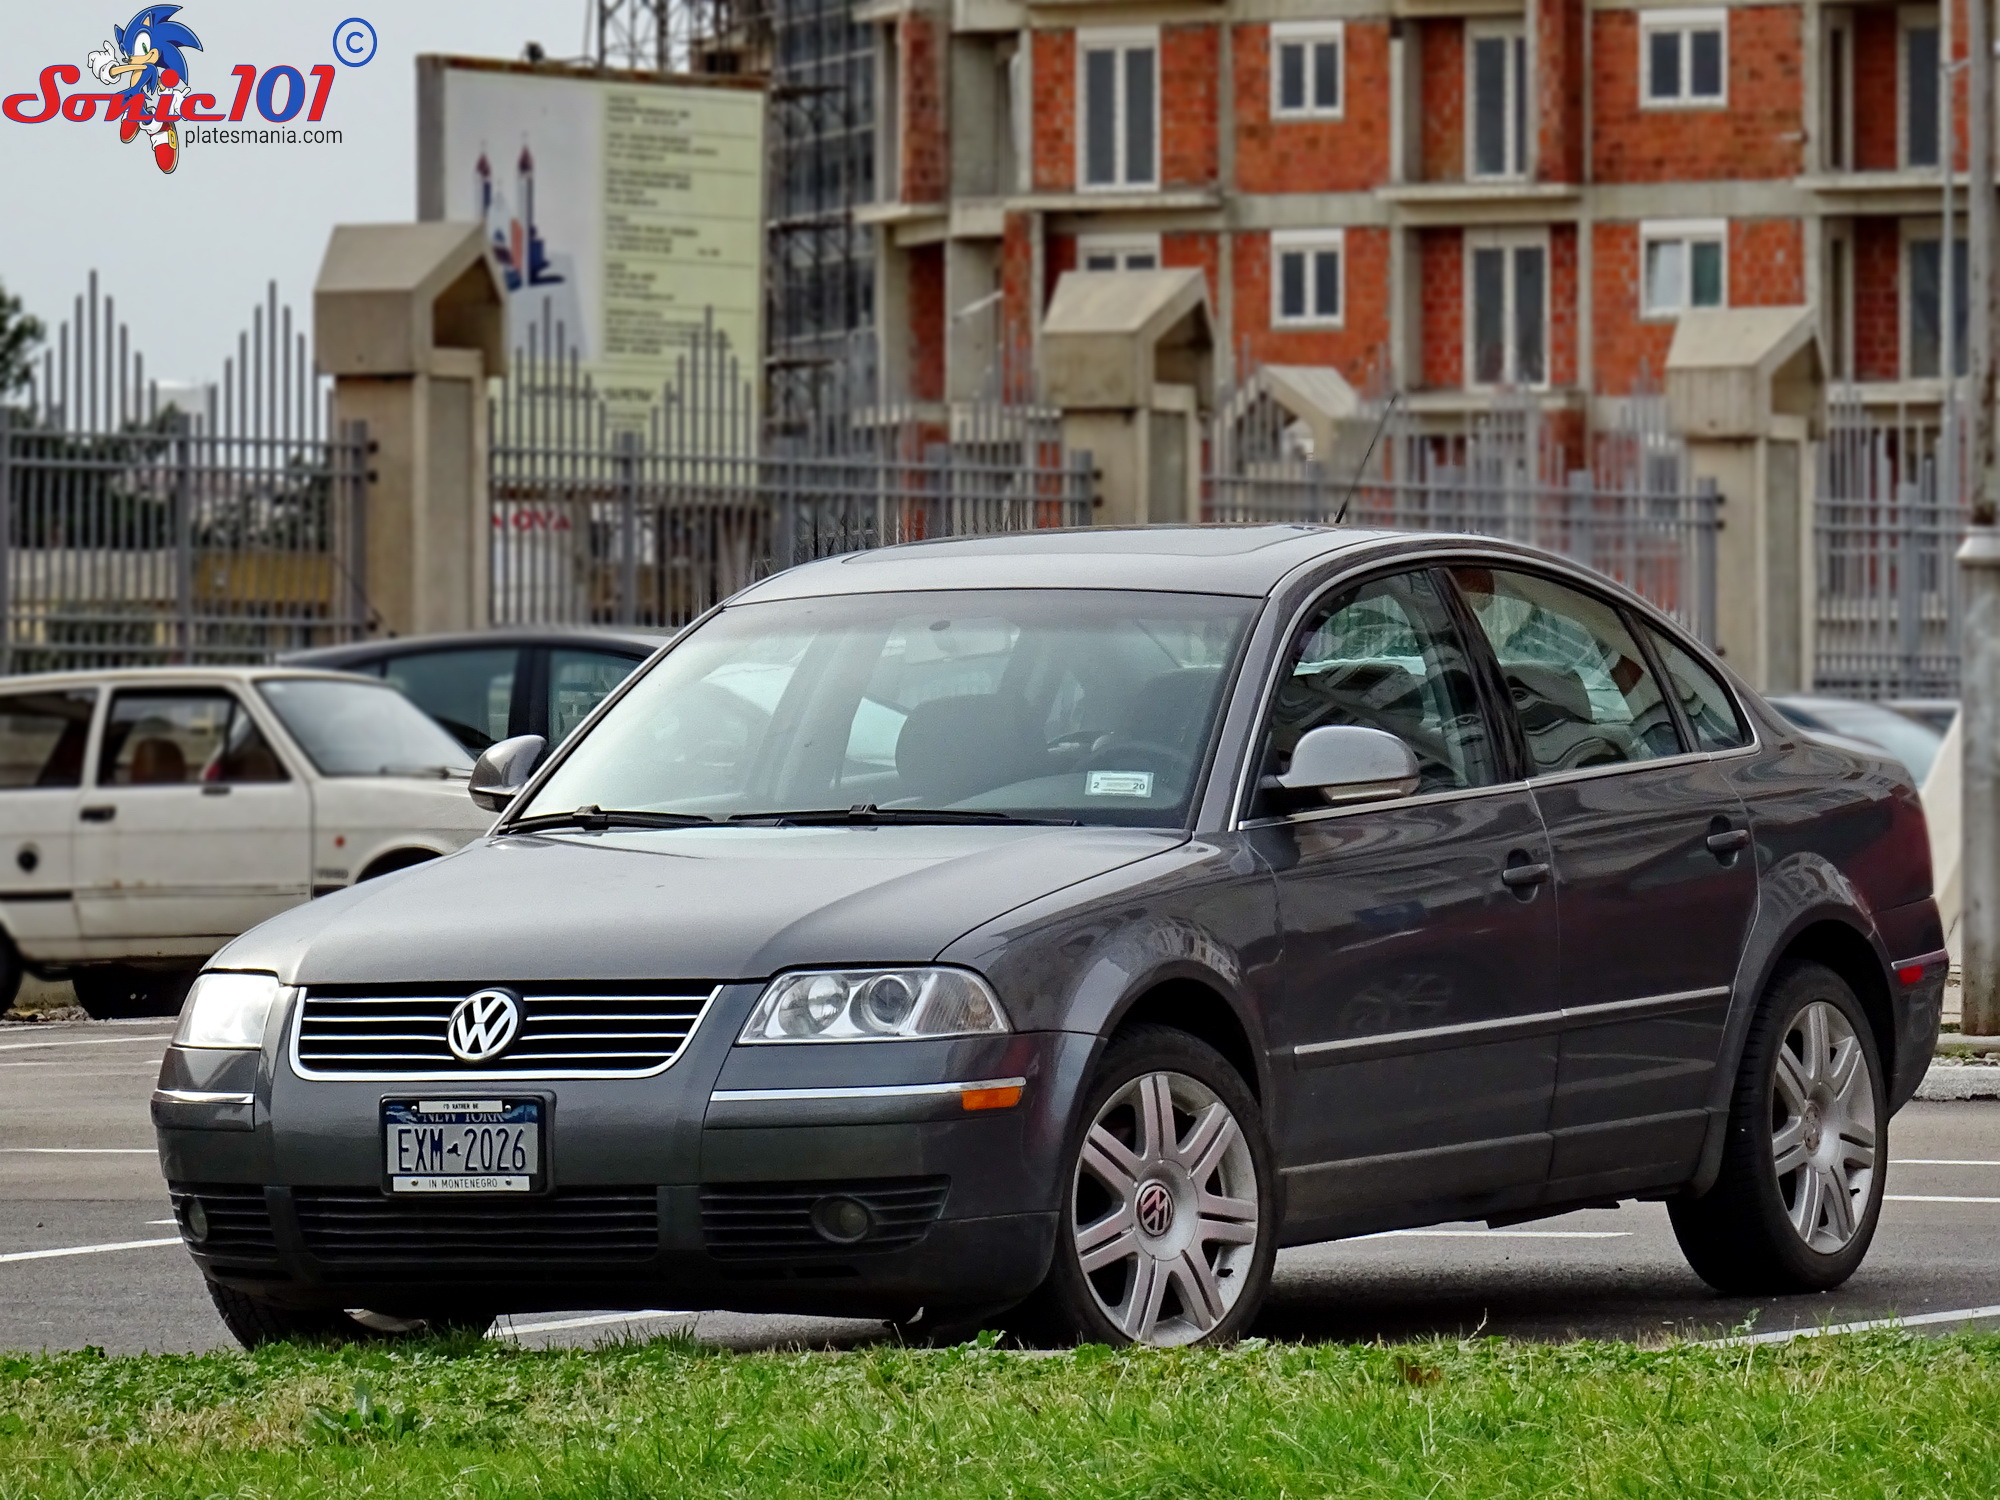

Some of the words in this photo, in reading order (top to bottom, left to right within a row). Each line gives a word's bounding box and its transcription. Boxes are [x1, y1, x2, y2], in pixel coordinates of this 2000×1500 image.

[1132, 782, 1146, 790] 20
[398, 1128, 444, 1171] EXM
[464, 1128, 526, 1171] 2026
[429, 1179, 437, 1188] IN
[441, 1178, 498, 1188] MONTENEGRO
